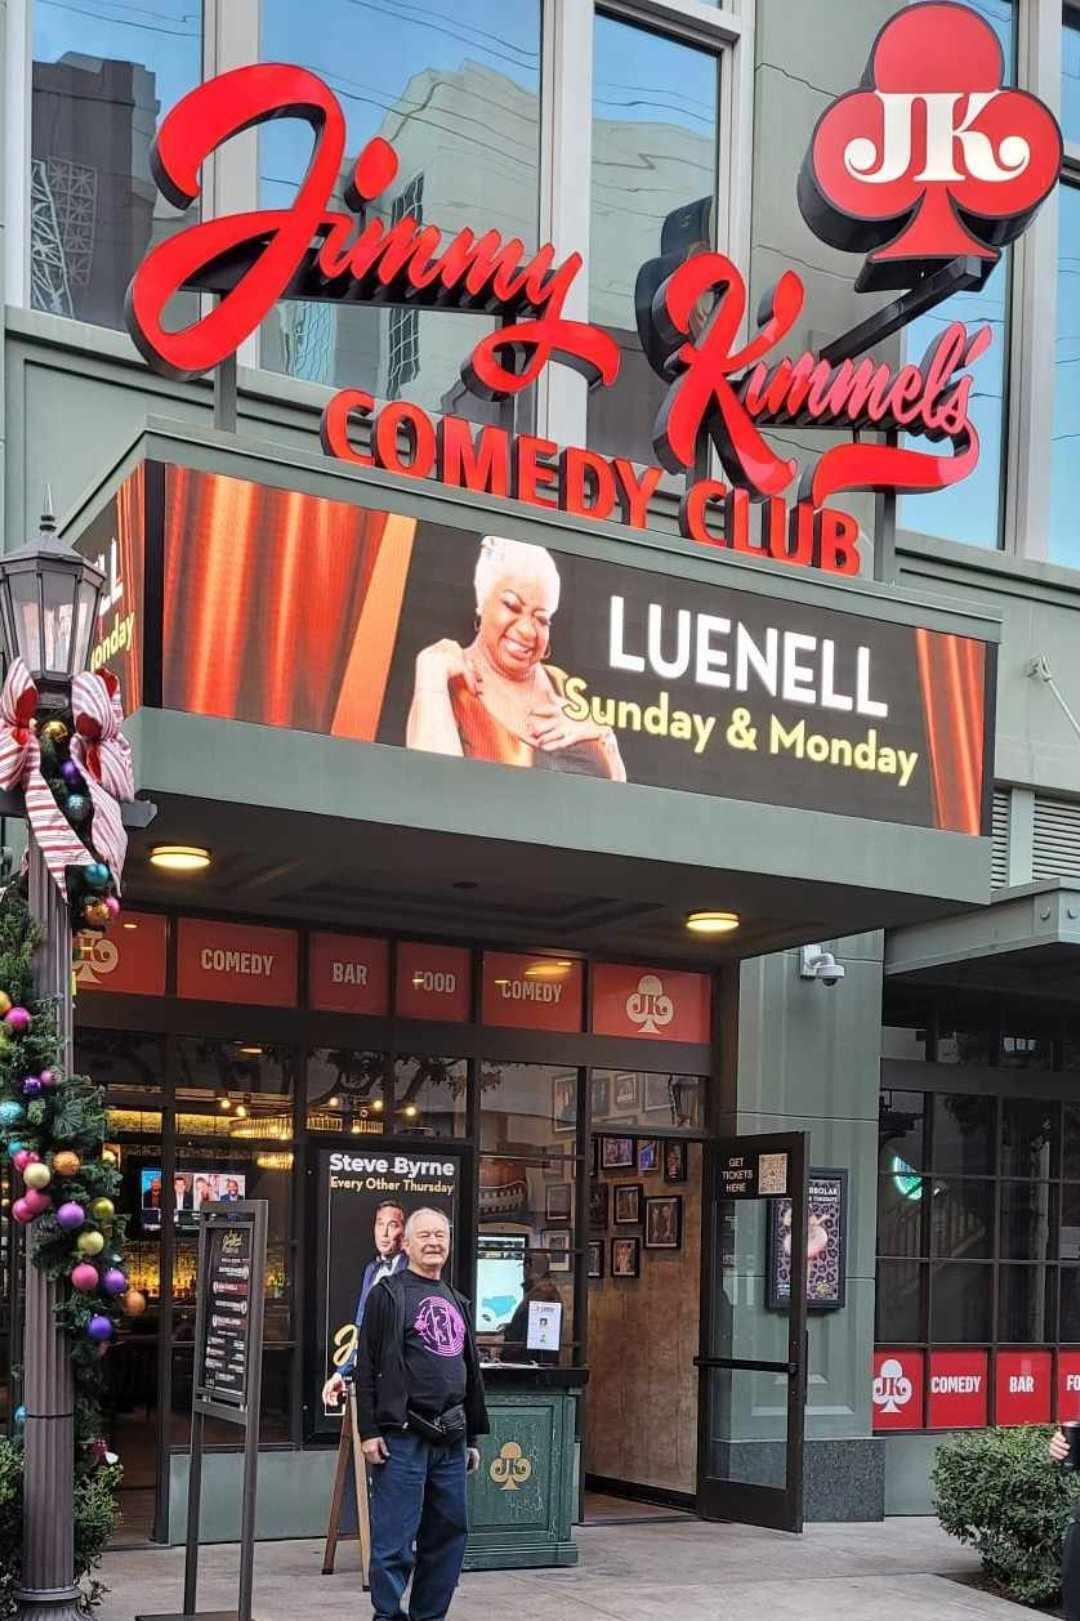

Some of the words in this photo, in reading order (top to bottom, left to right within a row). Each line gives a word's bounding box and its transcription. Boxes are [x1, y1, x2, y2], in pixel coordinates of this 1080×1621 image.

[843, 89, 1031, 183] JK
[128, 62, 621, 393] Jimmy
[665, 252, 993, 508] Kimmel's
[321, 389, 663, 529] COMEDY
[682, 481, 861, 577] CLUB
[91, 611, 135, 672] onday
[609, 595, 889, 718] LUENELL
[563, 677, 716, 754] Sunday
[726, 706, 757, 751] &
[769, 714, 919, 787] Monday
[200, 948, 274, 977] COMEDY
[332, 962, 368, 985] BAR
[414, 970, 456, 993] FOOD
[501, 980, 562, 1003] COMEDY
[329, 1153, 389, 1173] Steve
[393, 1156, 455, 1179] Byrne
[728, 1157, 744, 1167] GET
[329, 1175, 363, 1193] Every
[365, 1177, 400, 1192] Other
[402, 1179, 454, 1196] Thursday
[720, 1169, 753, 1181] TICKETS
[725, 1182, 746, 1193] HERE
[931, 1375, 982, 1394] COMEDY
[1008, 1375, 1035, 1393] BAR
